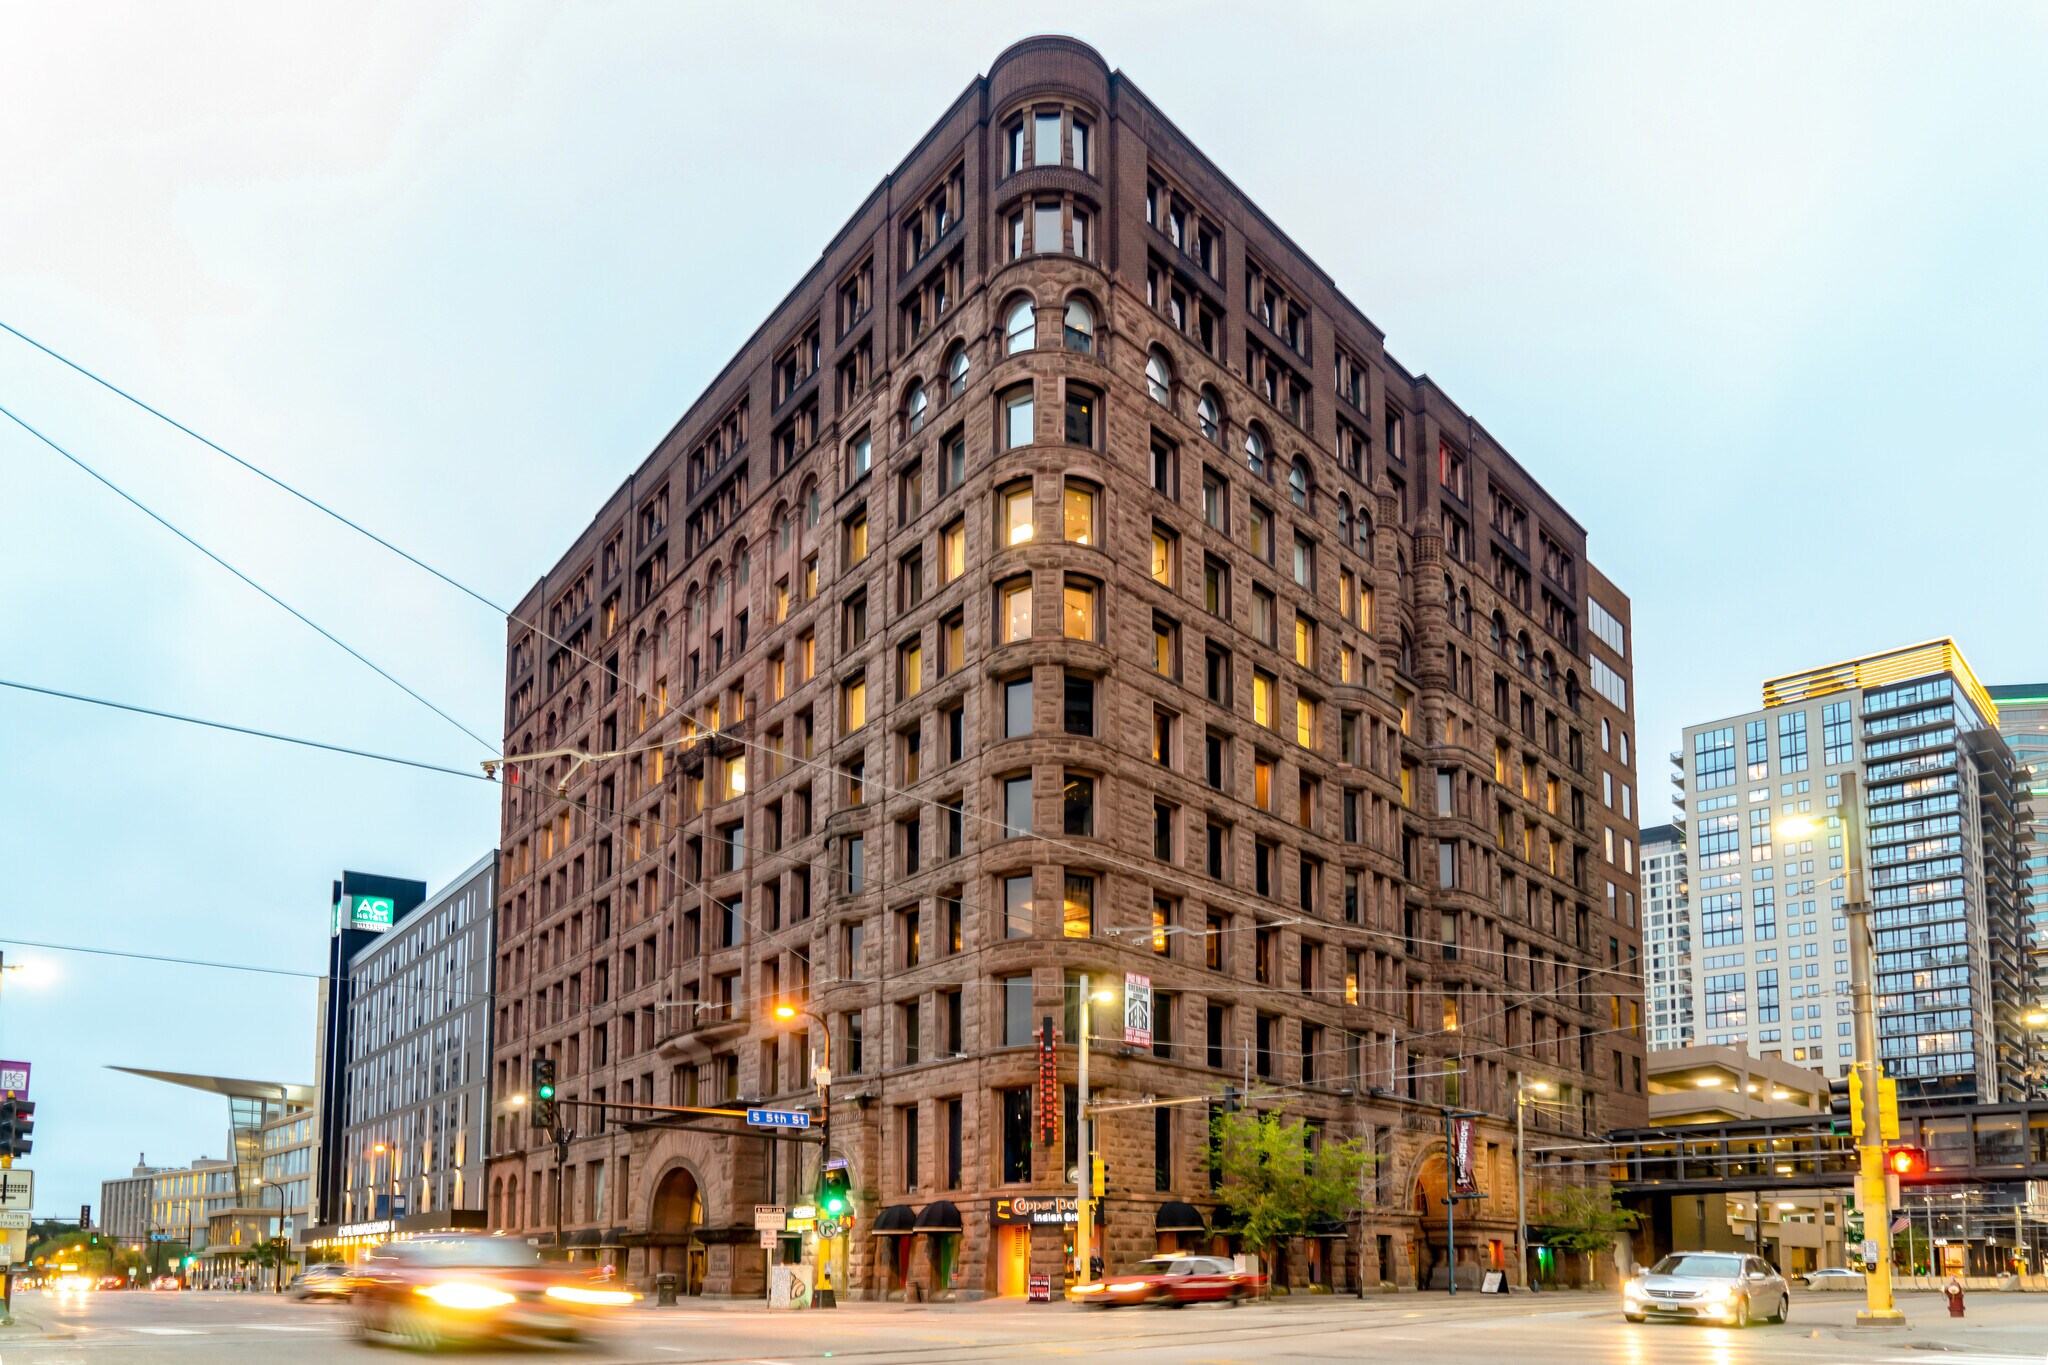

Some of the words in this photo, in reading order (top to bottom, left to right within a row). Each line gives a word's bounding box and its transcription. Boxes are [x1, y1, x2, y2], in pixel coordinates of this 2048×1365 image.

[357, 899, 389, 916] AC
[753, 1112, 760, 1122] S
[766, 1113, 787, 1124] 5th
[792, 1115, 805, 1125] St
[1011, 1197, 1055, 1215] Copper
[1033, 1212, 1062, 1222] Indian
